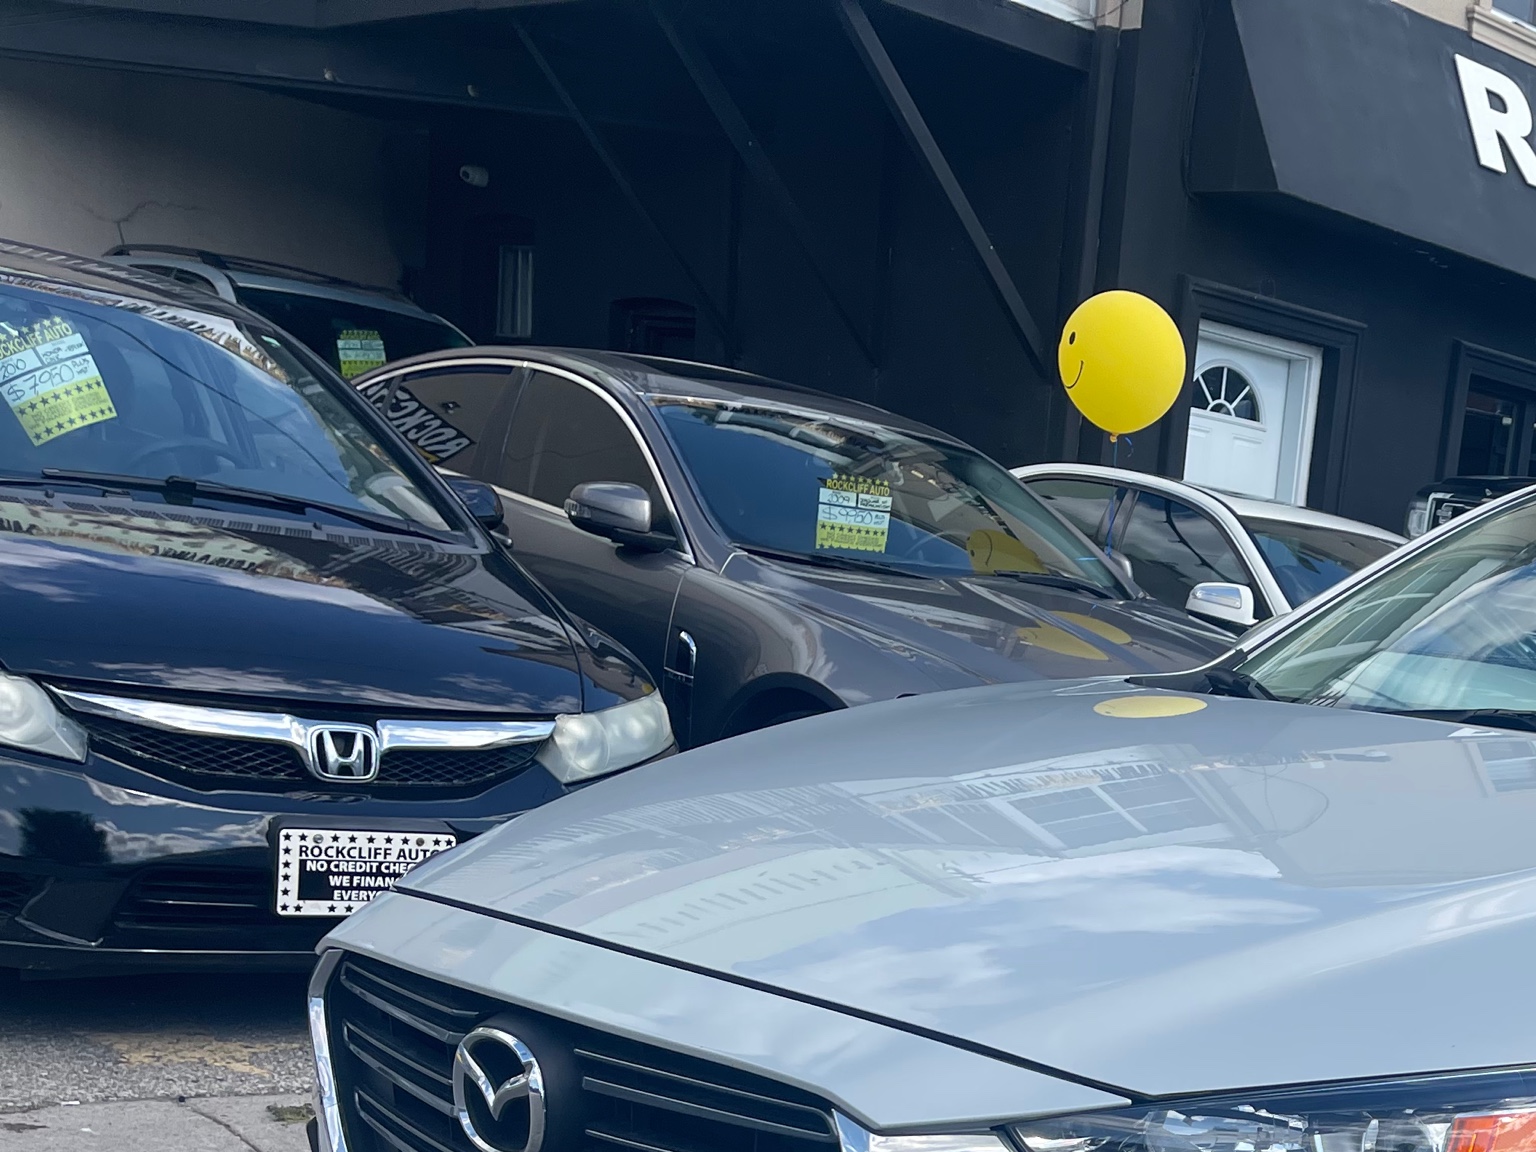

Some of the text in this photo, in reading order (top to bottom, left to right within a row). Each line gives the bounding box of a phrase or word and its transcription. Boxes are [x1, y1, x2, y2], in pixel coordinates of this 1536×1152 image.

[44, 322, 73, 341] AUTO
[826, 479, 890, 496] ROCKCLIFF AUTO
[299, 845, 393, 860] ROCKCLIFF
[306, 860, 328, 872] NO
[329, 861, 379, 873] CREDIT
[328, 875, 350, 887] WE
